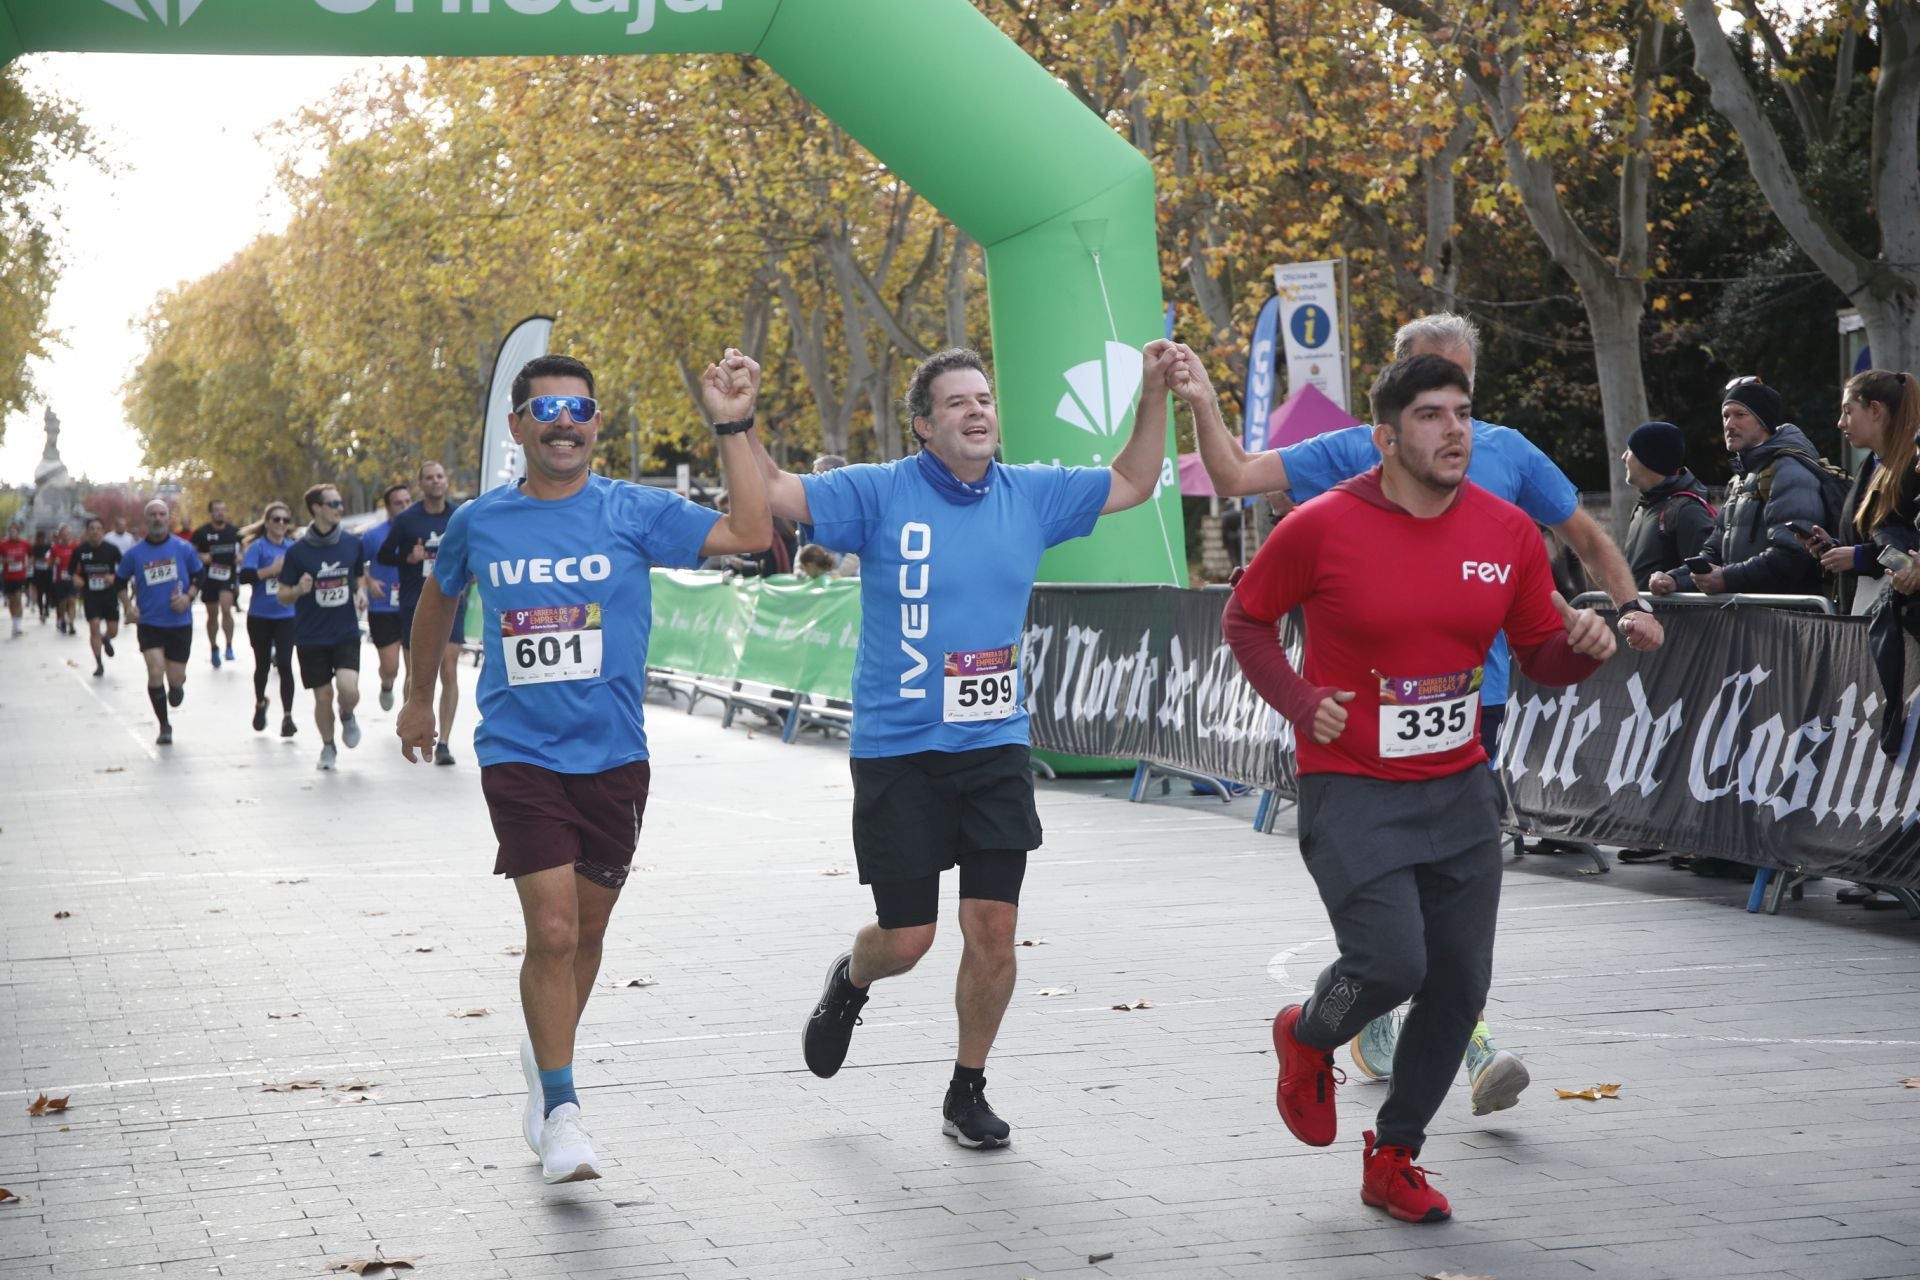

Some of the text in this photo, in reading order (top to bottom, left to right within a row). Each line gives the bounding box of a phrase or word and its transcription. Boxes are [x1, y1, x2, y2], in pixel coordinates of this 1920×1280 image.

[1250, 340, 1271, 452] VECO
[489, 554, 611, 588] IVECO
[322, 589, 345, 602] 722
[530, 607, 558, 617] CARRERA
[899, 521, 931, 698] IVECO
[530, 615, 568, 625] EMPRESAS
[516, 634, 582, 669] 601
[958, 675, 1012, 707] 599
[1418, 676, 1448, 687] CARRERA
[1418, 684, 1456, 695] EMPRESAS
[1397, 701, 1466, 741] 335
[1492, 663, 1920, 833] orte de Castill
